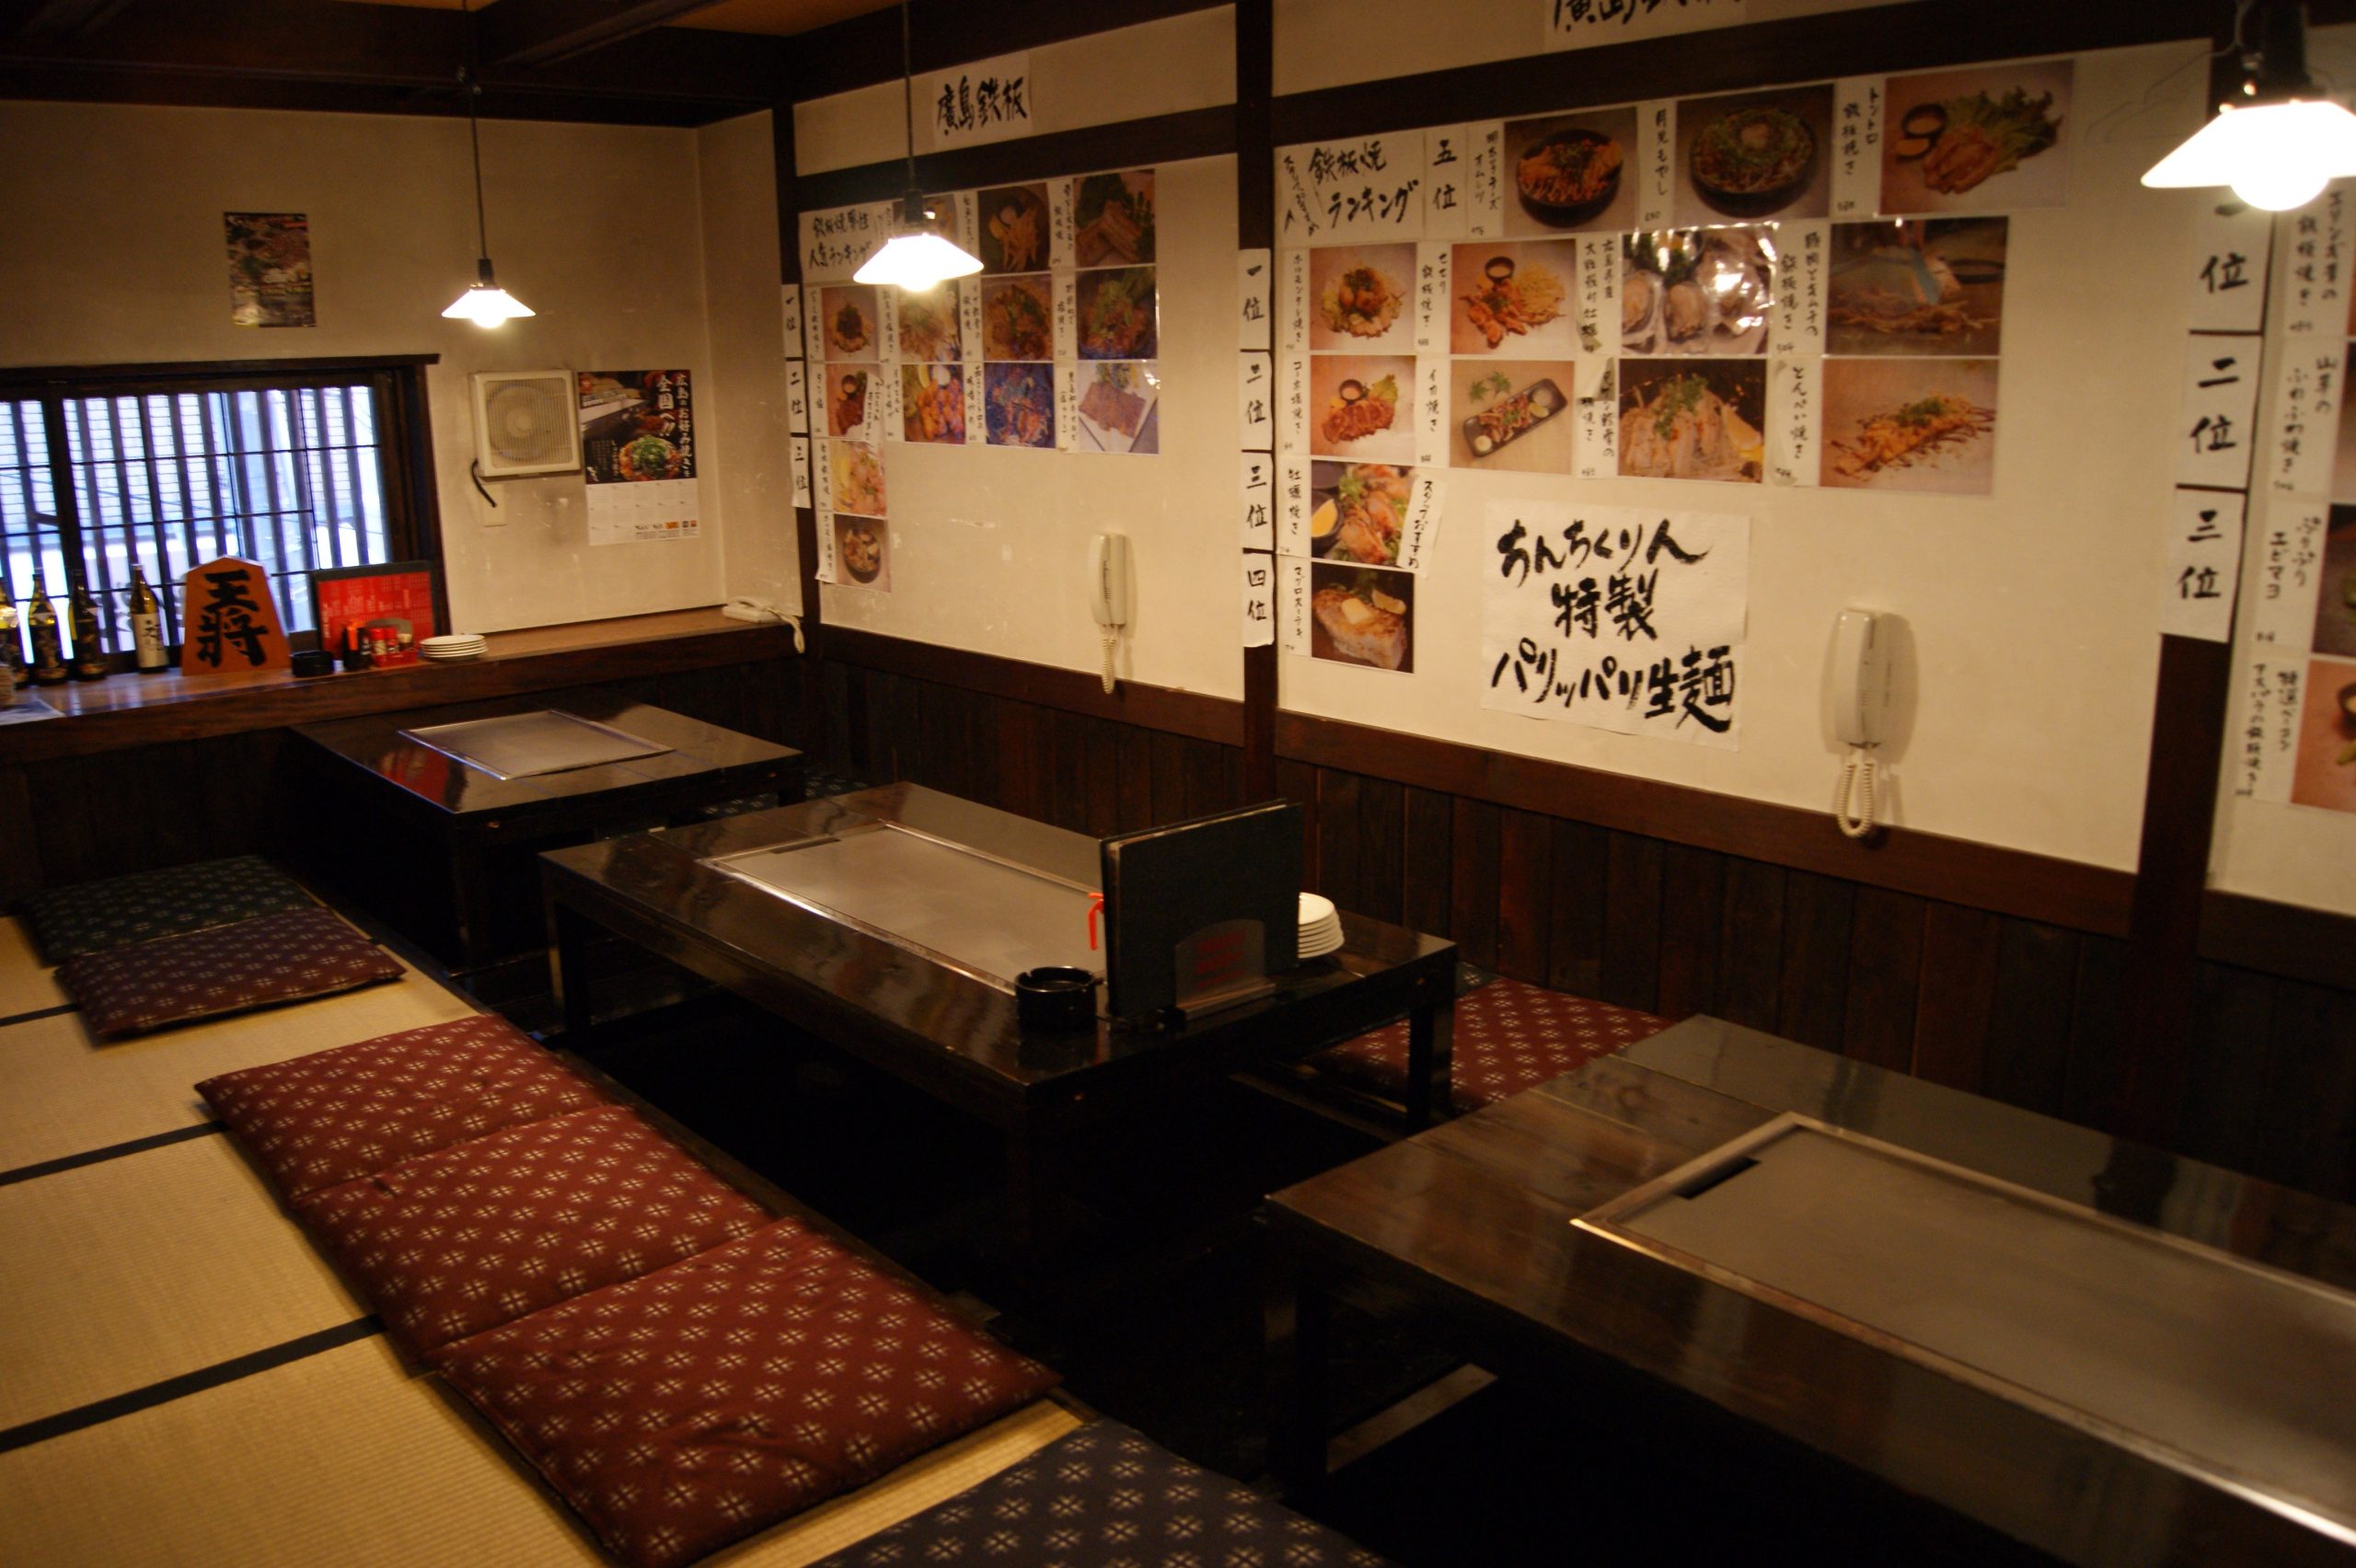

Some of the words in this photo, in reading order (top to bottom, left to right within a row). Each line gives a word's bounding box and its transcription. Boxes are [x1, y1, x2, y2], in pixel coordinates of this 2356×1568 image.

[1329, 179, 1419, 229] ランキング
[1433, 139, 1460, 211] 五位
[1244, 264, 1265, 322] 一位
[1246, 363, 1266, 424] 二位
[2190, 357, 2240, 454] 二位
[1246, 465, 1268, 529] 三位
[1408, 479, 1435, 570] スタッフおすすめ
[2177, 509, 2223, 600] 三位
[195, 568, 269, 668] 王将
[1246, 569, 1267, 621] 四位
[1551, 567, 1659, 642] 特製
